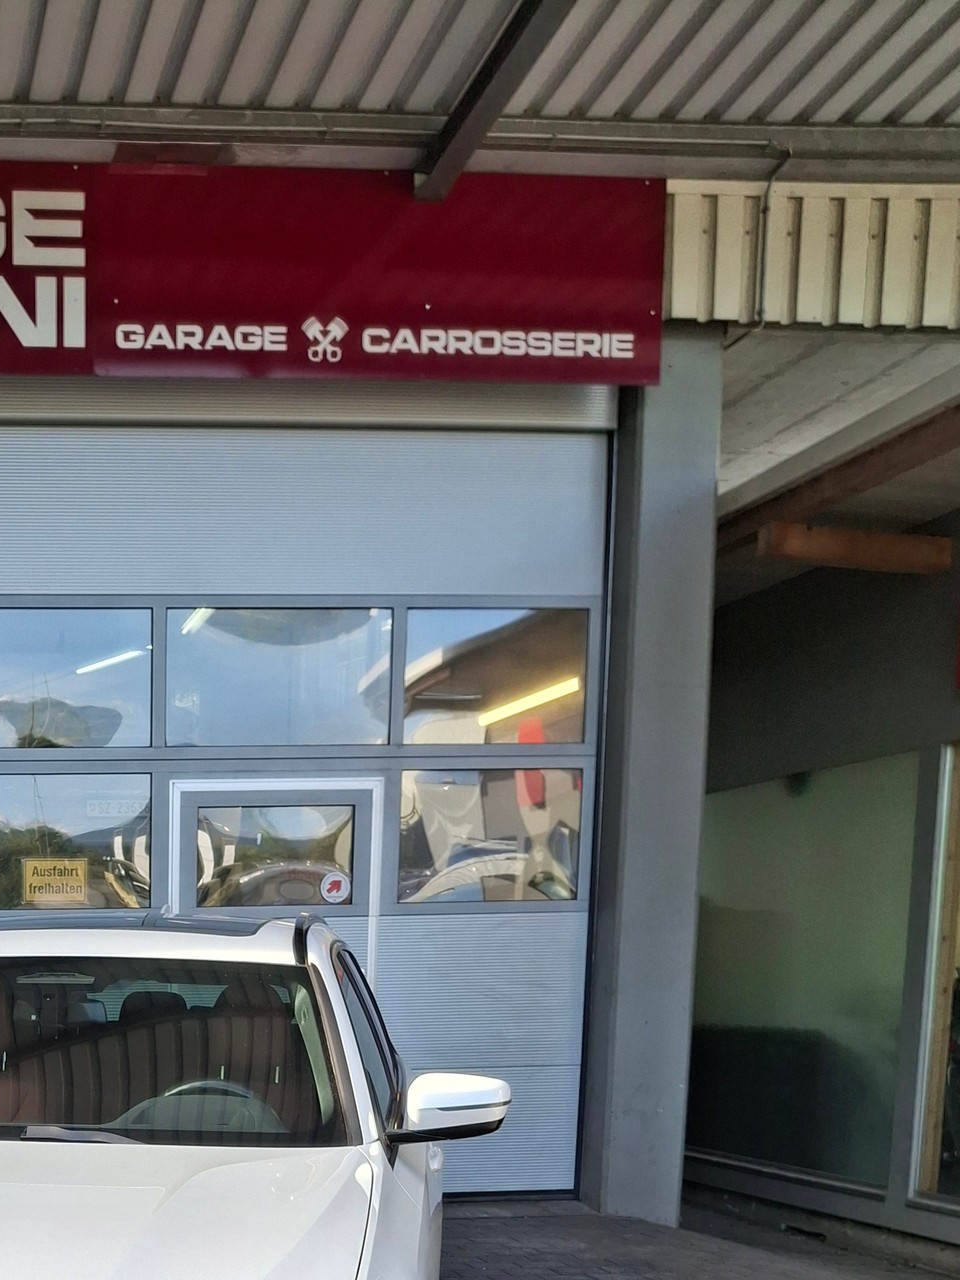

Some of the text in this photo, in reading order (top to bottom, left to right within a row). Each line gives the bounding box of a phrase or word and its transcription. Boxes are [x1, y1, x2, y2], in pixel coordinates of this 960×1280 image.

[115, 323, 635, 358] GARAGE CARROSSERIE
[31, 865, 79, 877] Ausfahrt
[28, 882, 83, 895] freihalten
